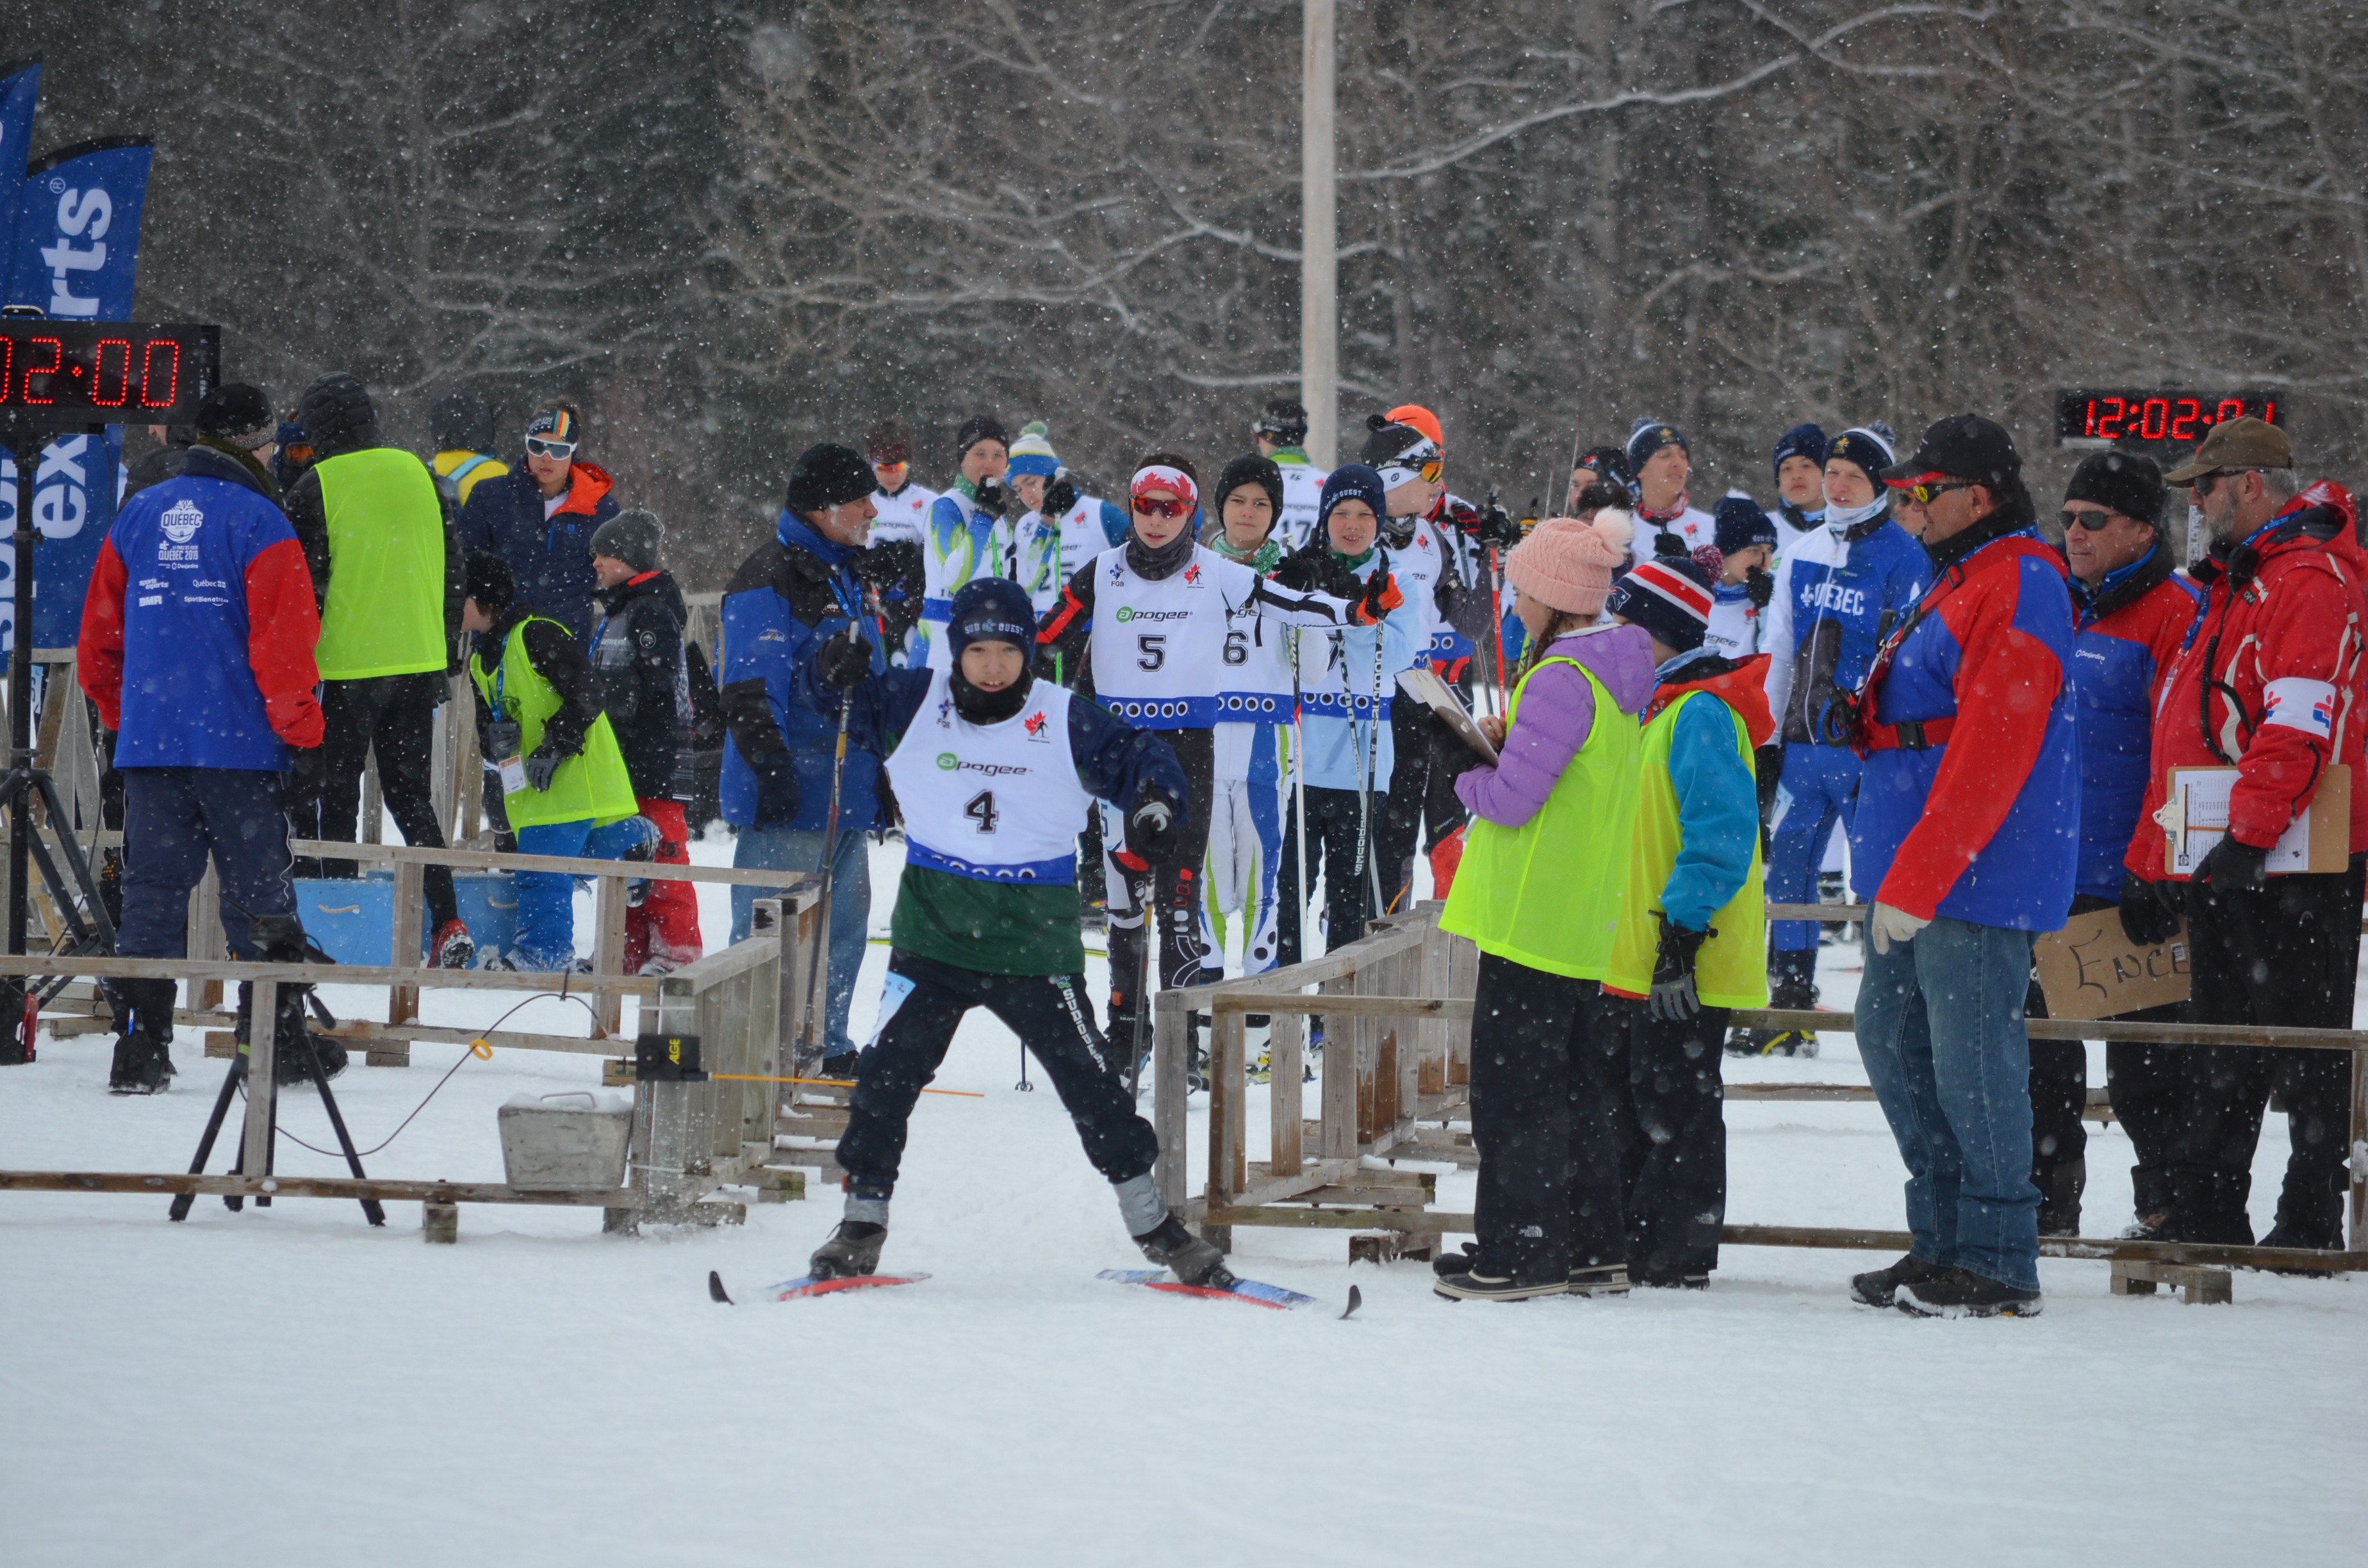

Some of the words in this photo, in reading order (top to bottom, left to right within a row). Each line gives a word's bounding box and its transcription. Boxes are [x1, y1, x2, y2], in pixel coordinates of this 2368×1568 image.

[138, 596, 163, 607] BMR
[964, 623, 980, 634] SUD
[998, 623, 1024, 636] OUEST
[1137, 634, 1166, 673] 5
[1222, 630, 1249, 666] 6
[963, 789, 999, 834] 4
[669, 1039, 680, 1065] ALGE
